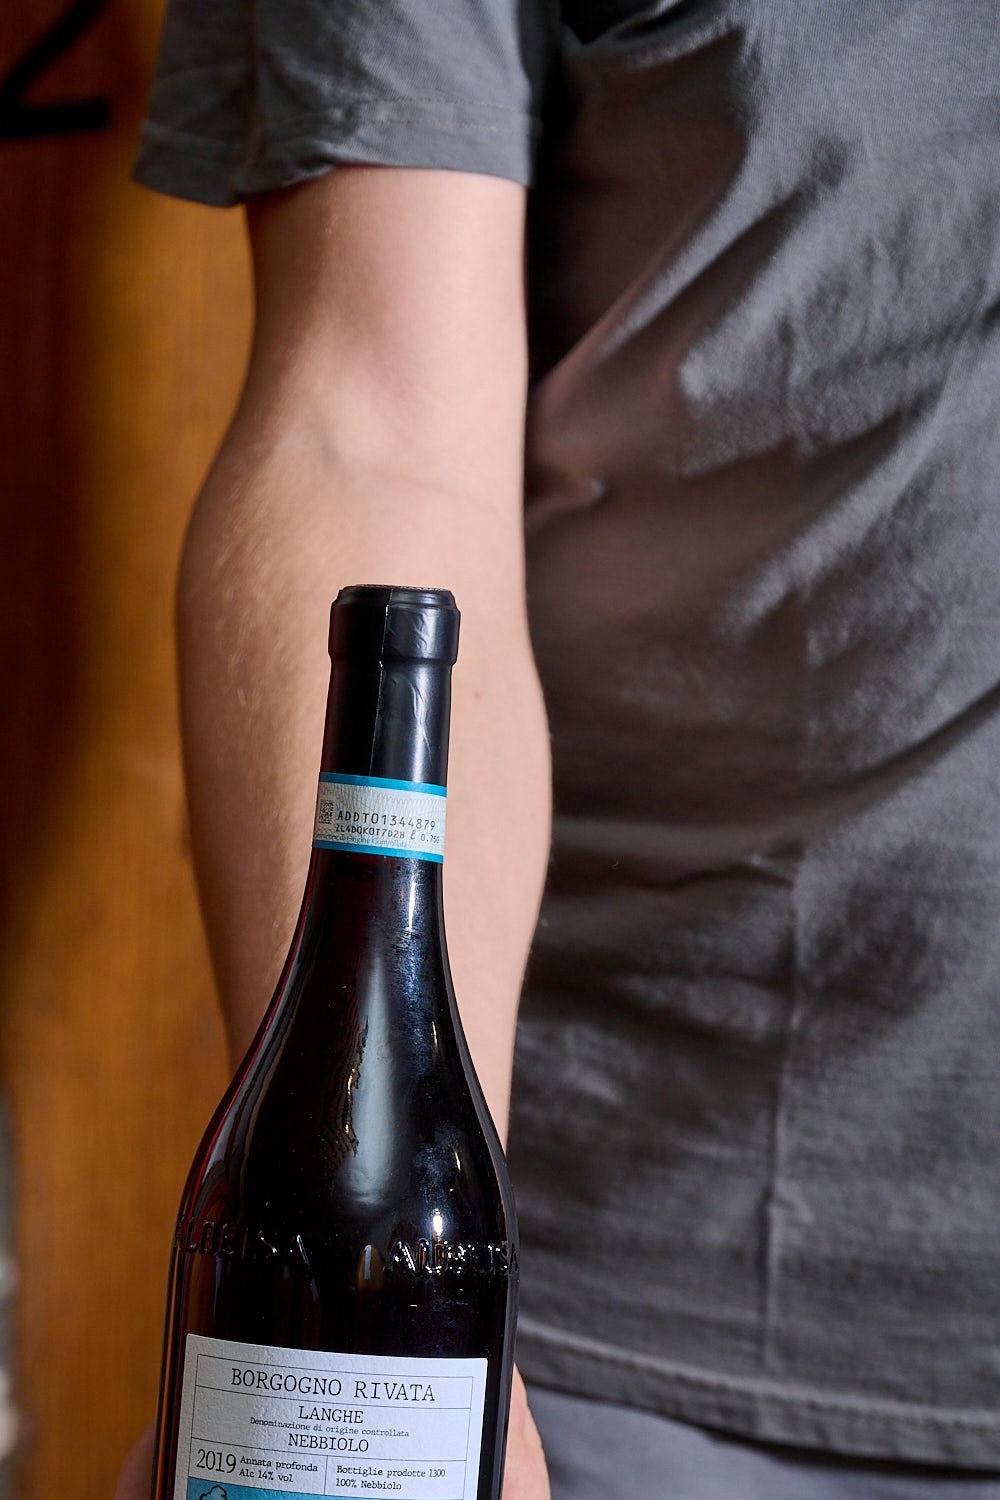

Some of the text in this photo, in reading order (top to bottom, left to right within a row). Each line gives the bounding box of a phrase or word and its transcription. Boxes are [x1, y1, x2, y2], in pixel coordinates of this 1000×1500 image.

[230, 1368, 436, 1402] BORGOGNO RIVATA
[298, 1406, 364, 1424] LANGHE
[250, 1416, 410, 1438] Denominazione di origine controllata
[288, 1433, 369, 1453] NEBBIOLO
[196, 1449, 237, 1474] 2019
[240, 1456, 318, 1473] Annata profonda
[239, 1468, 294, 1483] Alc 14% vol
[336, 1465, 383, 1478] Bottiglie
[386, 1467, 426, 1479] prodotte
[335, 1478, 402, 1491] 100% Nebbiolo
